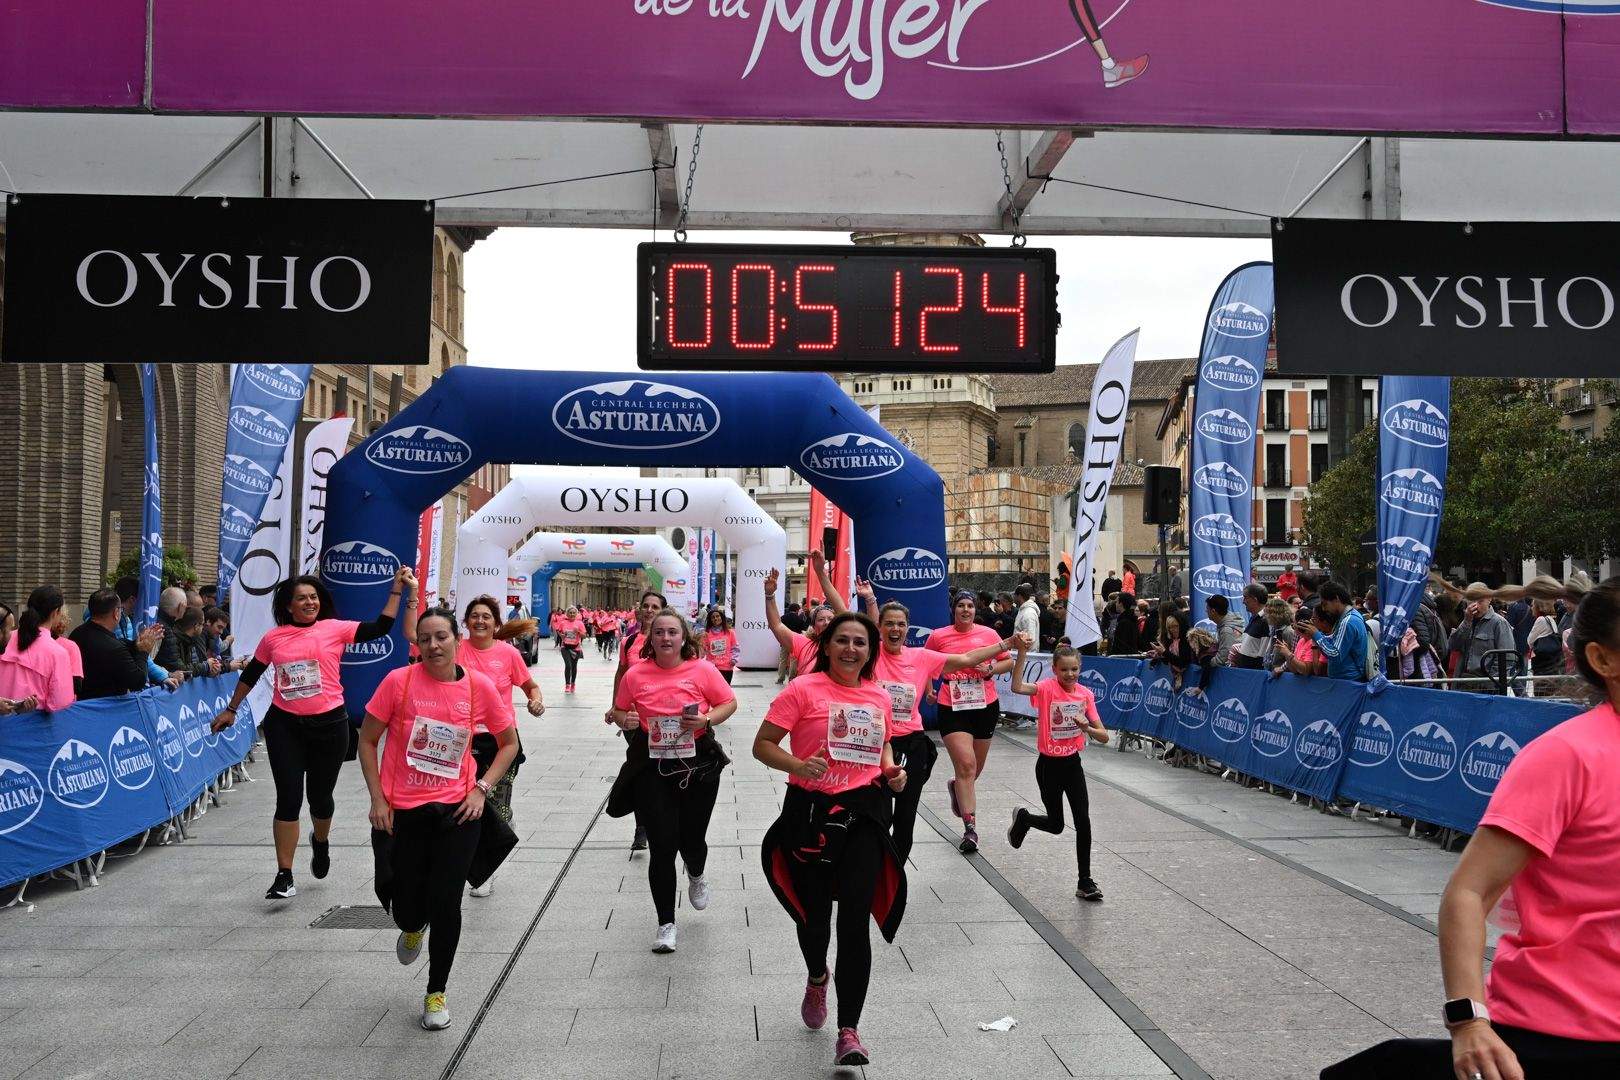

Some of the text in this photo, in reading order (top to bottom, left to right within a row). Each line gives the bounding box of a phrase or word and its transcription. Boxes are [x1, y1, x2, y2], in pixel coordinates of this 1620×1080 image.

[76, 249, 372, 313] OYSHO
[1340, 274, 1615, 330] OYSHO
[1216, 314, 1264, 332] ASTURIANA
[246, 364, 300, 396] ASTURIANA
[1206, 365, 1254, 384] ASTURIANA
[592, 400, 702, 409] CENTRAL LECHERA
[564, 400, 708, 433] ASTURIANA
[1389, 411, 1446, 441] ASTURIANA
[230, 410, 286, 444] ASTURIANA
[1201, 418, 1247, 438] ASTURIANA
[372, 442, 462, 463] ASTURIANA
[390, 440, 422, 448] CENTRAL
[809, 452, 898, 468] ASTURIANA
[1075, 380, 1126, 592] OYSHO
[1198, 471, 1243, 492] ASTURIANA
[560, 487, 688, 513] OYSHO
[1383, 480, 1440, 509] ASTURIAN
[482, 516, 522, 524] OYSHO
[724, 516, 762, 524] OYSHO
[324, 555, 394, 576] ASTURIANA
[462, 567, 500, 576] OYSHO
[744, 569, 772, 578] OYSH
[872, 564, 942, 582] ASTURIANA
[742, 621, 770, 630] OYSH
[345, 642, 387, 655] RIANA
[850, 726, 868, 736] 016
[428, 740, 448, 752] 016
[1354, 736, 1388, 756] TURIANA
[1400, 738, 1450, 770] ASTURIANA
[113, 752, 153, 778] ASTURIANA
[1463, 751, 1506, 780] ASTURIA
[56, 767, 106, 796] ASTURIANA
[407, 772, 448, 787] SUMA
[0, 786, 38, 812] RIANA
